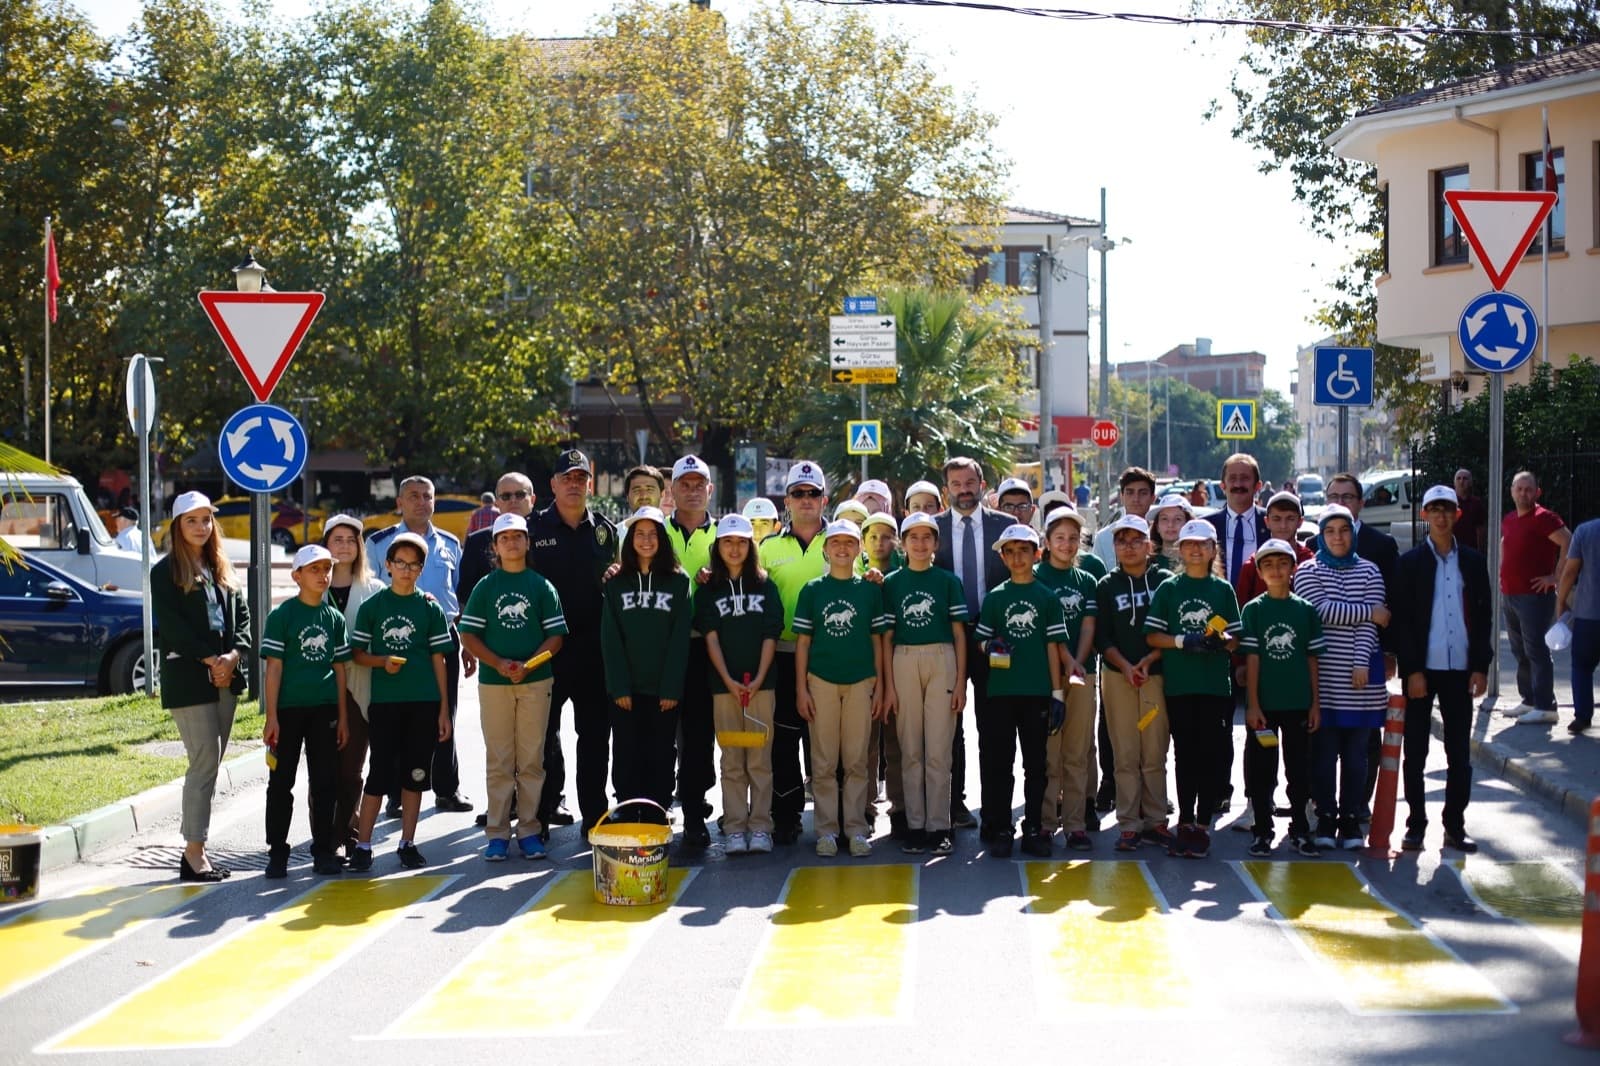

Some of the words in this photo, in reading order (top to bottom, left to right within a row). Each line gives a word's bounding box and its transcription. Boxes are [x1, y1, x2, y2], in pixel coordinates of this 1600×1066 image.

[1094, 428, 1117, 440] DUR
[621, 591, 673, 612] ETK
[715, 594, 765, 618] ETK
